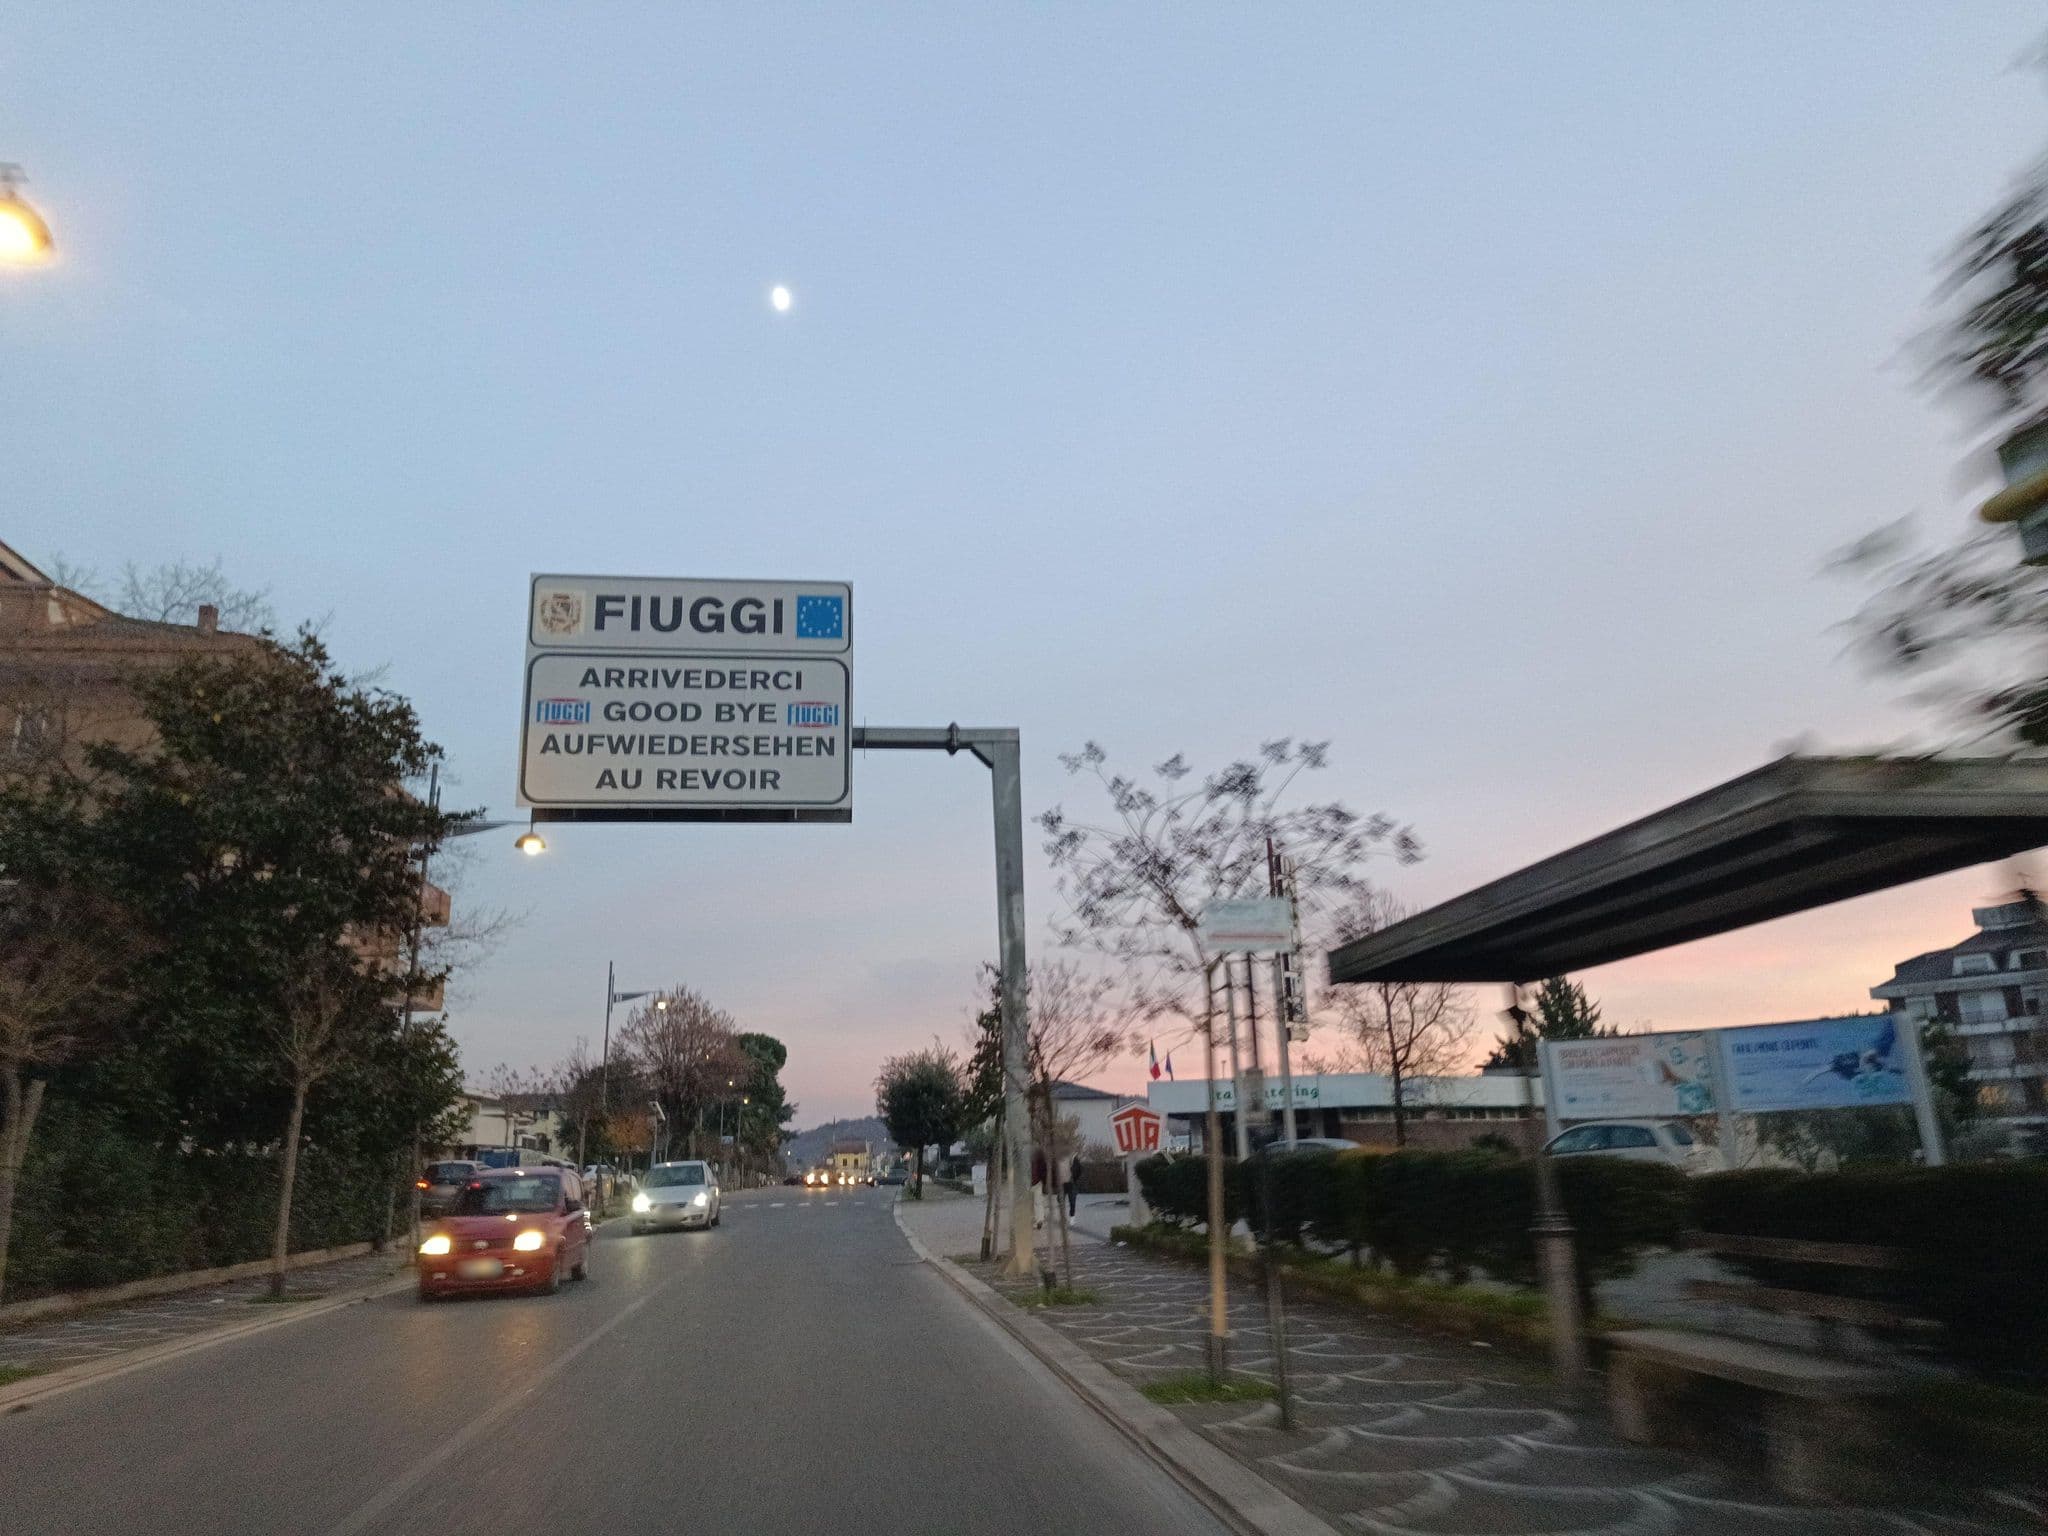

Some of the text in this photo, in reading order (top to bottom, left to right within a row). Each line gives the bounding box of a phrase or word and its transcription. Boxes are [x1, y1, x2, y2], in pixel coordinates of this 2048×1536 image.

[594, 594, 784, 635] FIUGGI
[579, 667, 802, 691] ARRIVEDERCI
[536, 700, 591, 723] FIUGGI
[603, 700, 777, 724] GOOD BYE
[787, 703, 839, 727] FIUGGI
[539, 733, 836, 757] AUFWIEDERSEHEN
[595, 768, 781, 791] AU REVOIR
[1113, 1107, 1160, 1152] UTA
